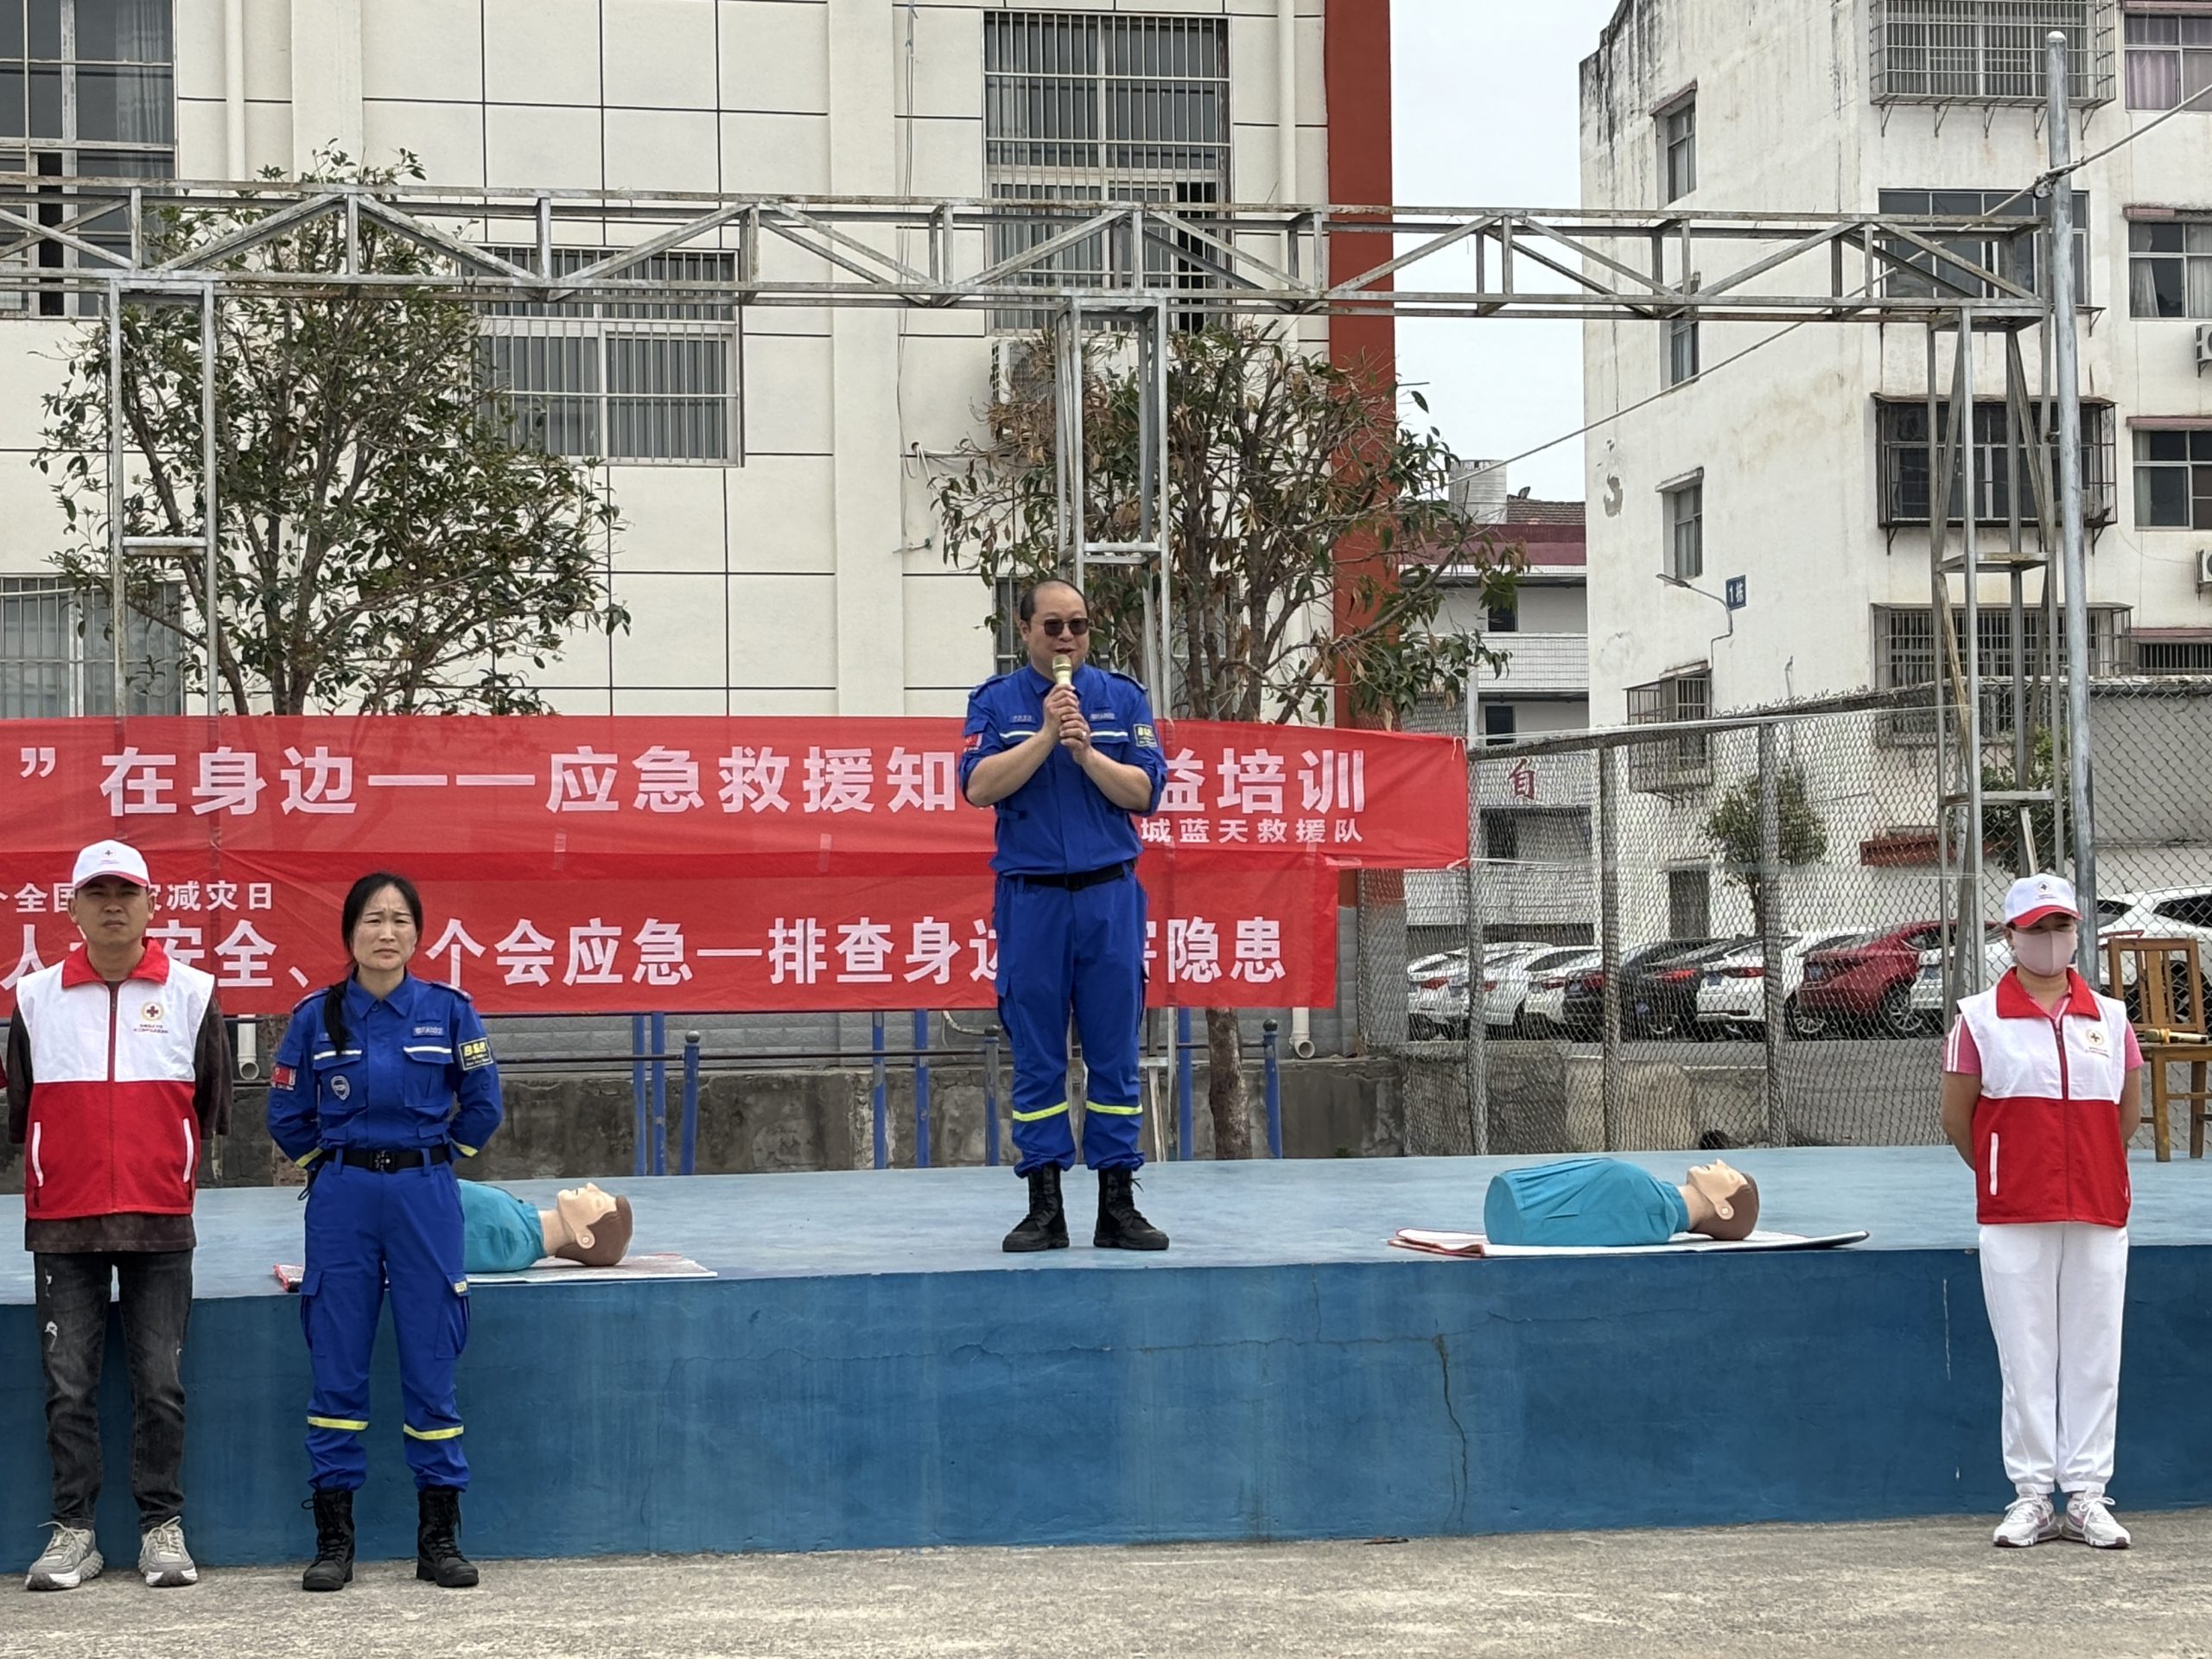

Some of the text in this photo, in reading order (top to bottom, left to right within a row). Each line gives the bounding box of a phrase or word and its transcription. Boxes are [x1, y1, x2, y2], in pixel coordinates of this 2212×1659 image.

[1508, 758, 1535, 800] 自
[1140, 817, 1363, 844] 城蓝天救援队
